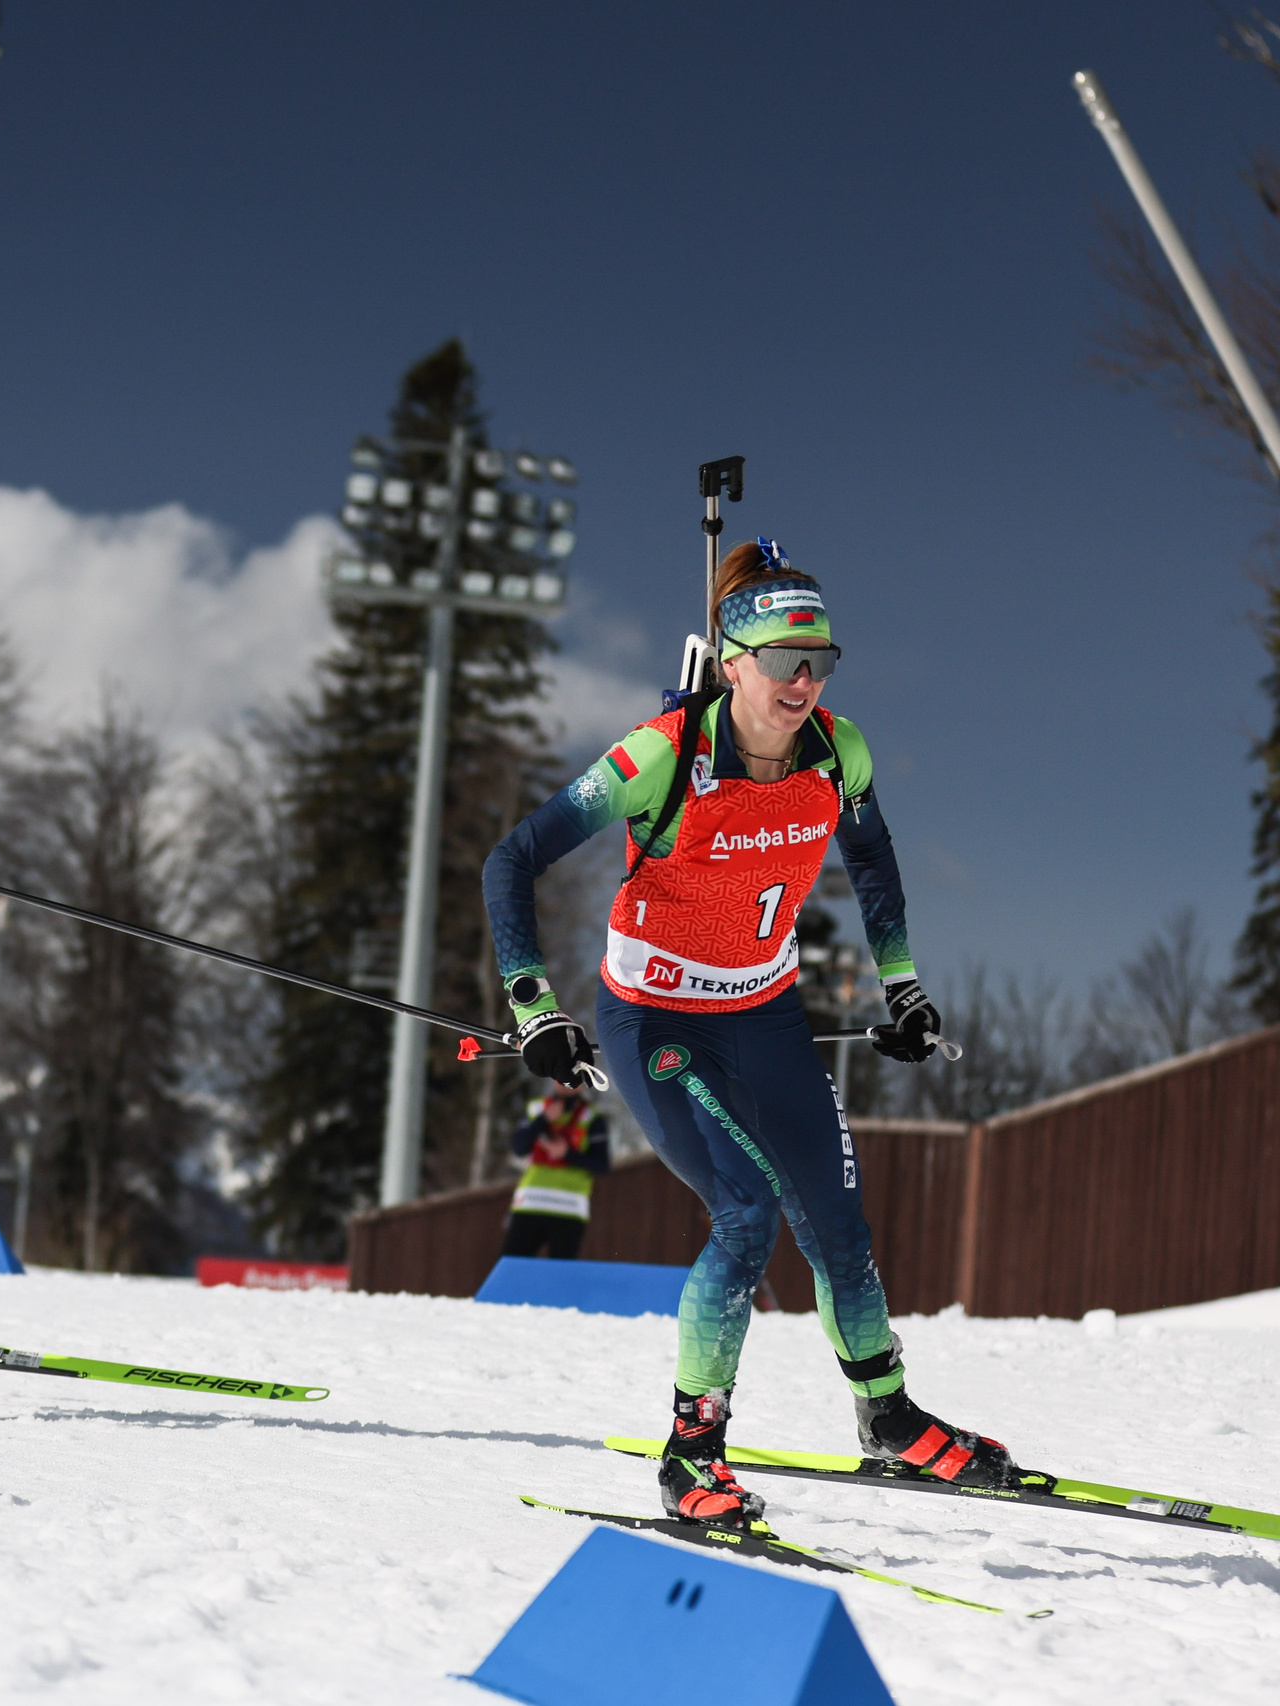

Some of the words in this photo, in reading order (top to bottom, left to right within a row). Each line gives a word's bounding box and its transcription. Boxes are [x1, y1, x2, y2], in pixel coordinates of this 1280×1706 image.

[710, 827, 783, 859] Альфа
[787, 821, 829, 844] Банк
[635, 900, 647, 926] 1
[755, 883, 786, 940] 1
[677, 1071, 781, 1197] БЕЛОРУСНЕФТЬ
[123, 1368, 263, 1394] FISCHER
[960, 1486, 1020, 1499] FISCHER
[705, 1530, 742, 1544] FISCHER
